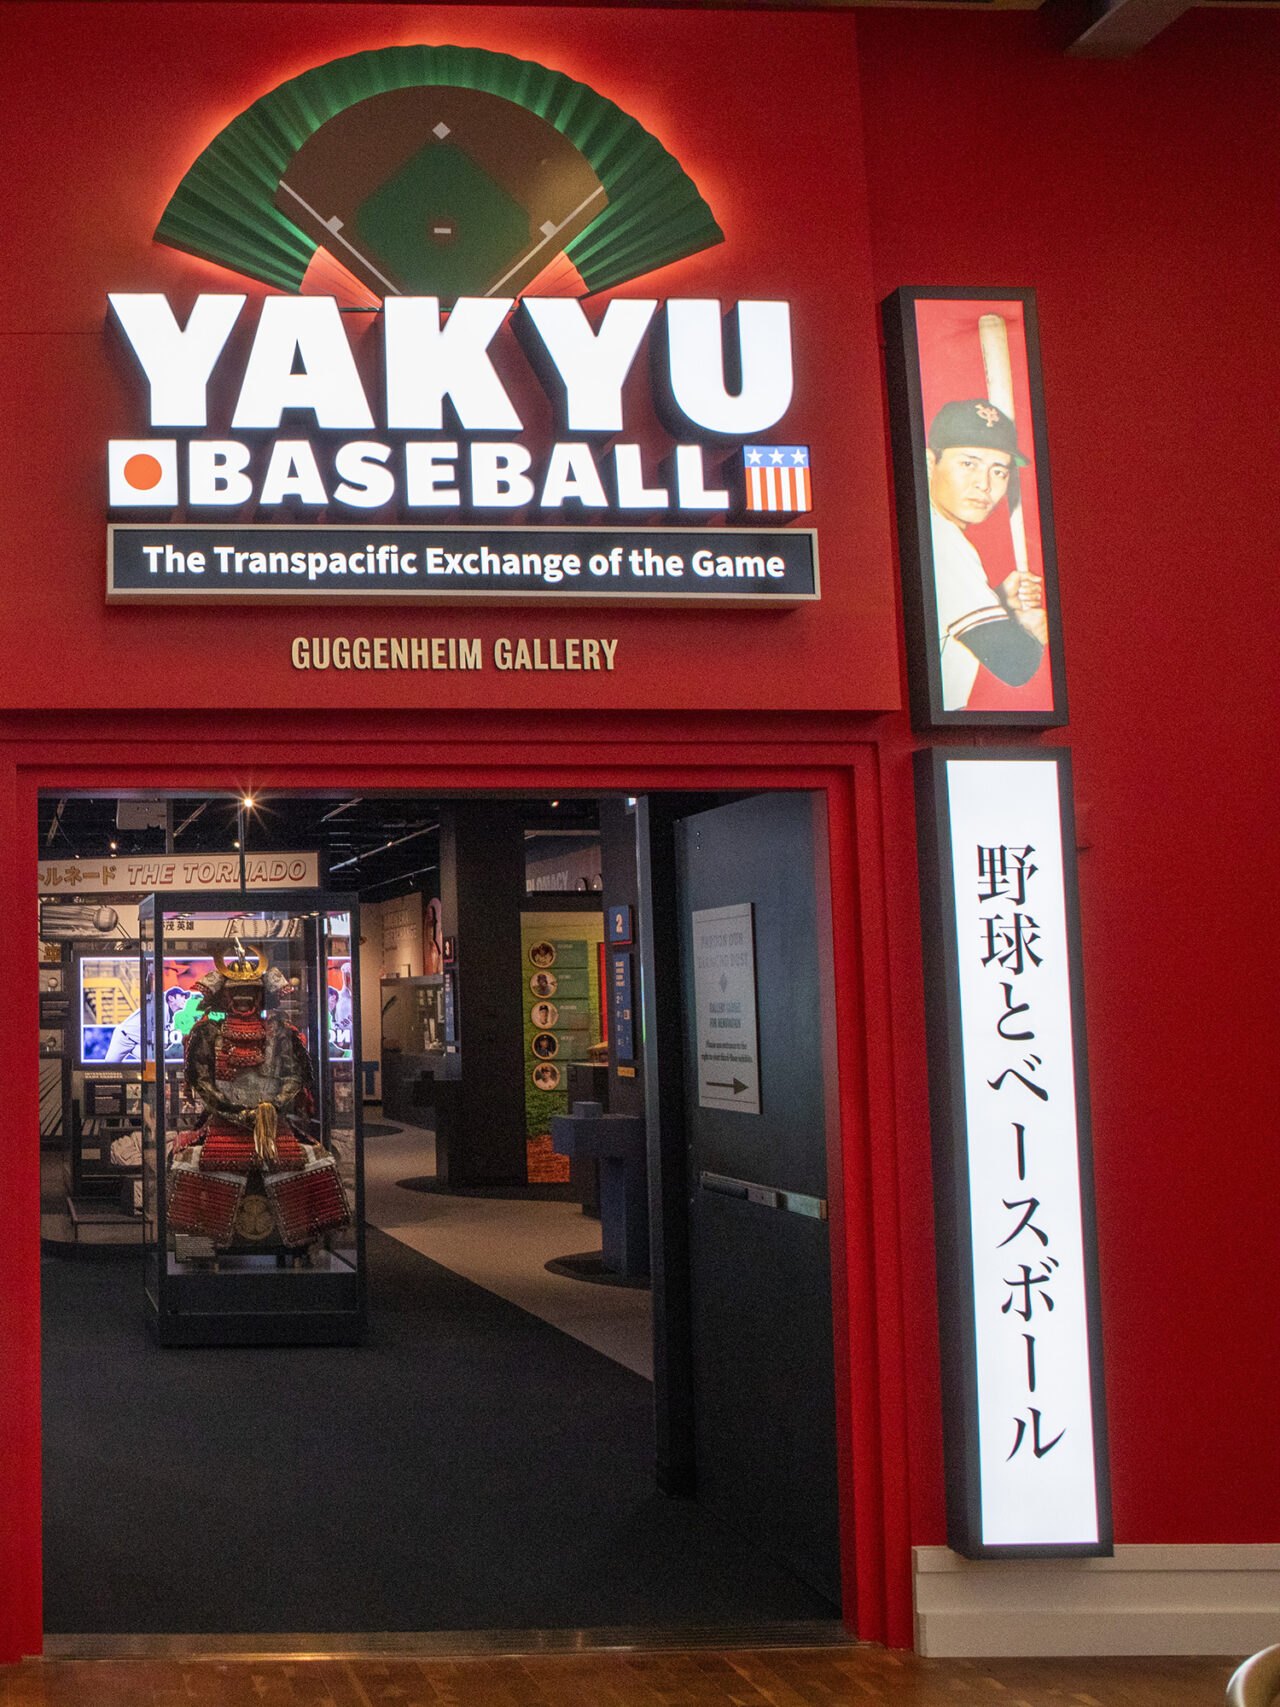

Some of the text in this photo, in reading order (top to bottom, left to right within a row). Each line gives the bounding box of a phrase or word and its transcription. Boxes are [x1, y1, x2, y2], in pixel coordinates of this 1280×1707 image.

[107, 293, 793, 434] YAKYU
[188, 440, 730, 509] BASEBALL
[142, 544, 786, 584] The Transpacific Exchange of the Game
[291, 637, 619, 671] GUGGENHEIM GALLERY
[127, 859, 308, 886] THE TORNADO
[616, 913, 624, 934] 2
[976, 843, 1067, 1464] 野球とベースボール
